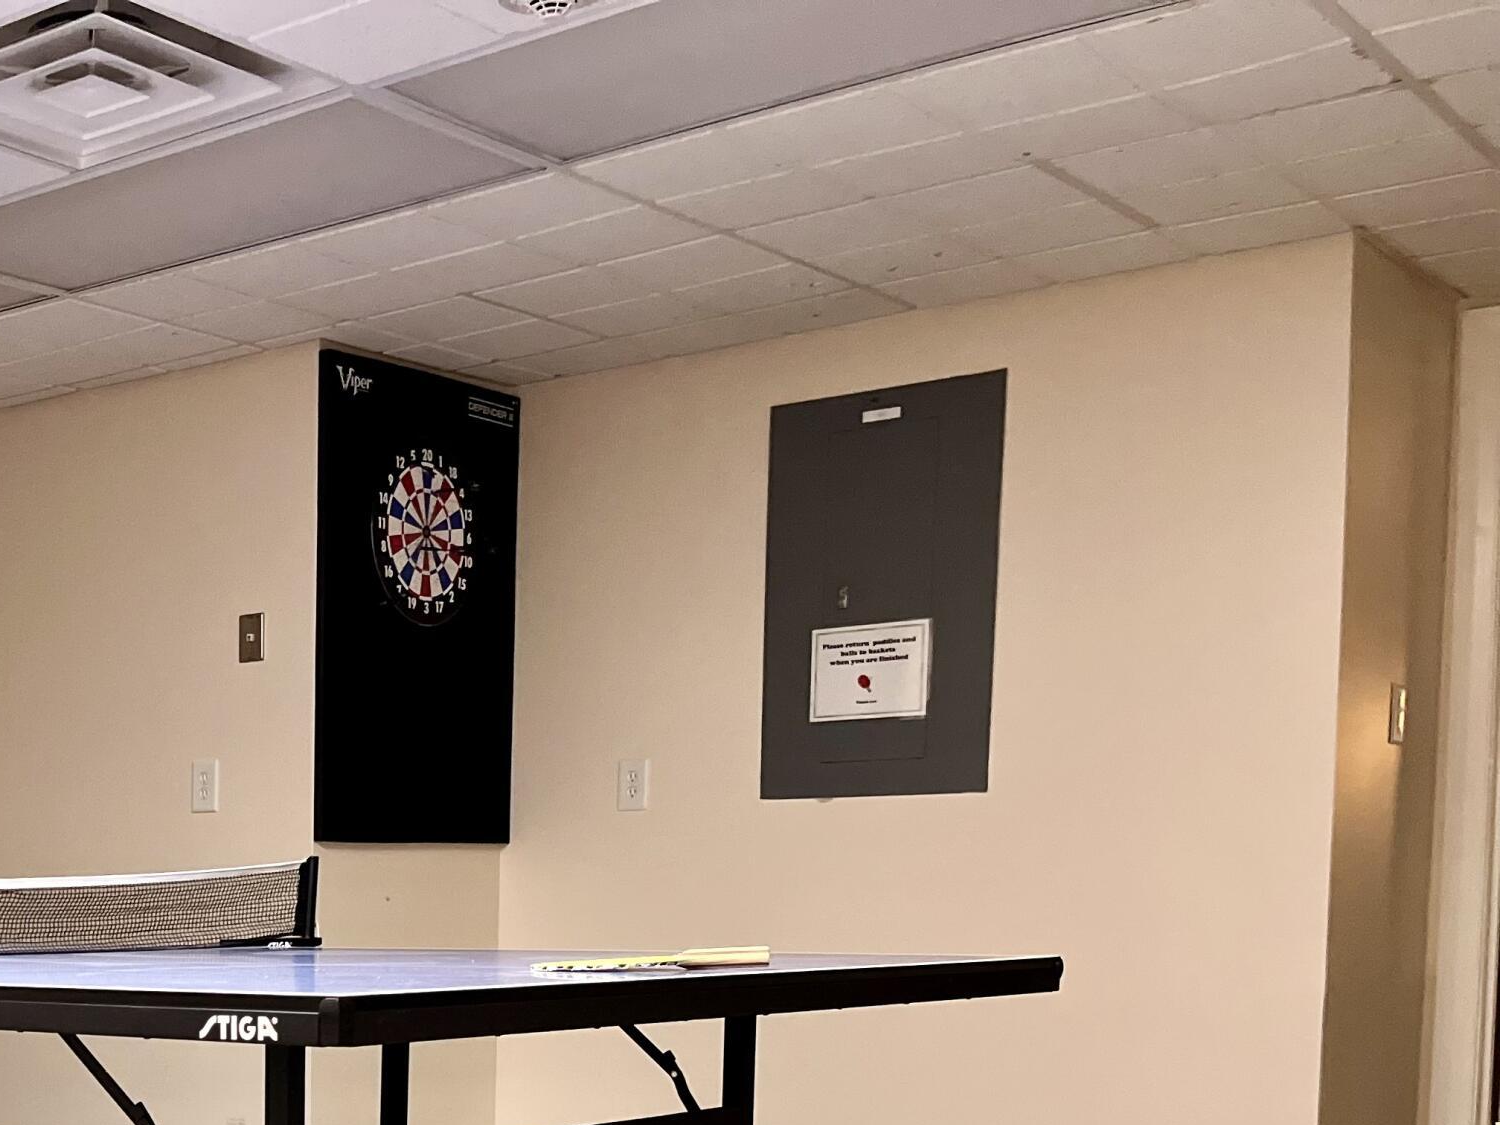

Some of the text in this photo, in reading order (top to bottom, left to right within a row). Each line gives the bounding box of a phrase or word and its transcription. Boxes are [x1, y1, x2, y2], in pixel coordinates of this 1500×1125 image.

[336, 364, 373, 396] Viper
[468, 401, 507, 420] DEFENDER
[410, 450, 416, 461] 5
[422, 449, 433, 462] 20
[439, 456, 443, 467] 1
[396, 456, 404, 468] 12
[449, 467, 458, 479] 18
[388, 474, 394, 486] 9
[379, 492, 388, 504] 14
[459, 488, 464, 499] 4
[464, 510, 473, 522] 13
[378, 517, 386, 529] 11
[466, 533, 472, 544] 6
[381, 540, 386, 552] 8
[464, 556, 473, 568] 10
[384, 565, 393, 578] 16
[396, 584, 402, 593] 7
[458, 577, 466, 590] 15
[408, 597, 416, 609] 19
[449, 592, 454, 603] 2
[424, 602, 430, 614] 3
[435, 601, 444, 614] 17
[199, 1015, 278, 1041] STIGA
